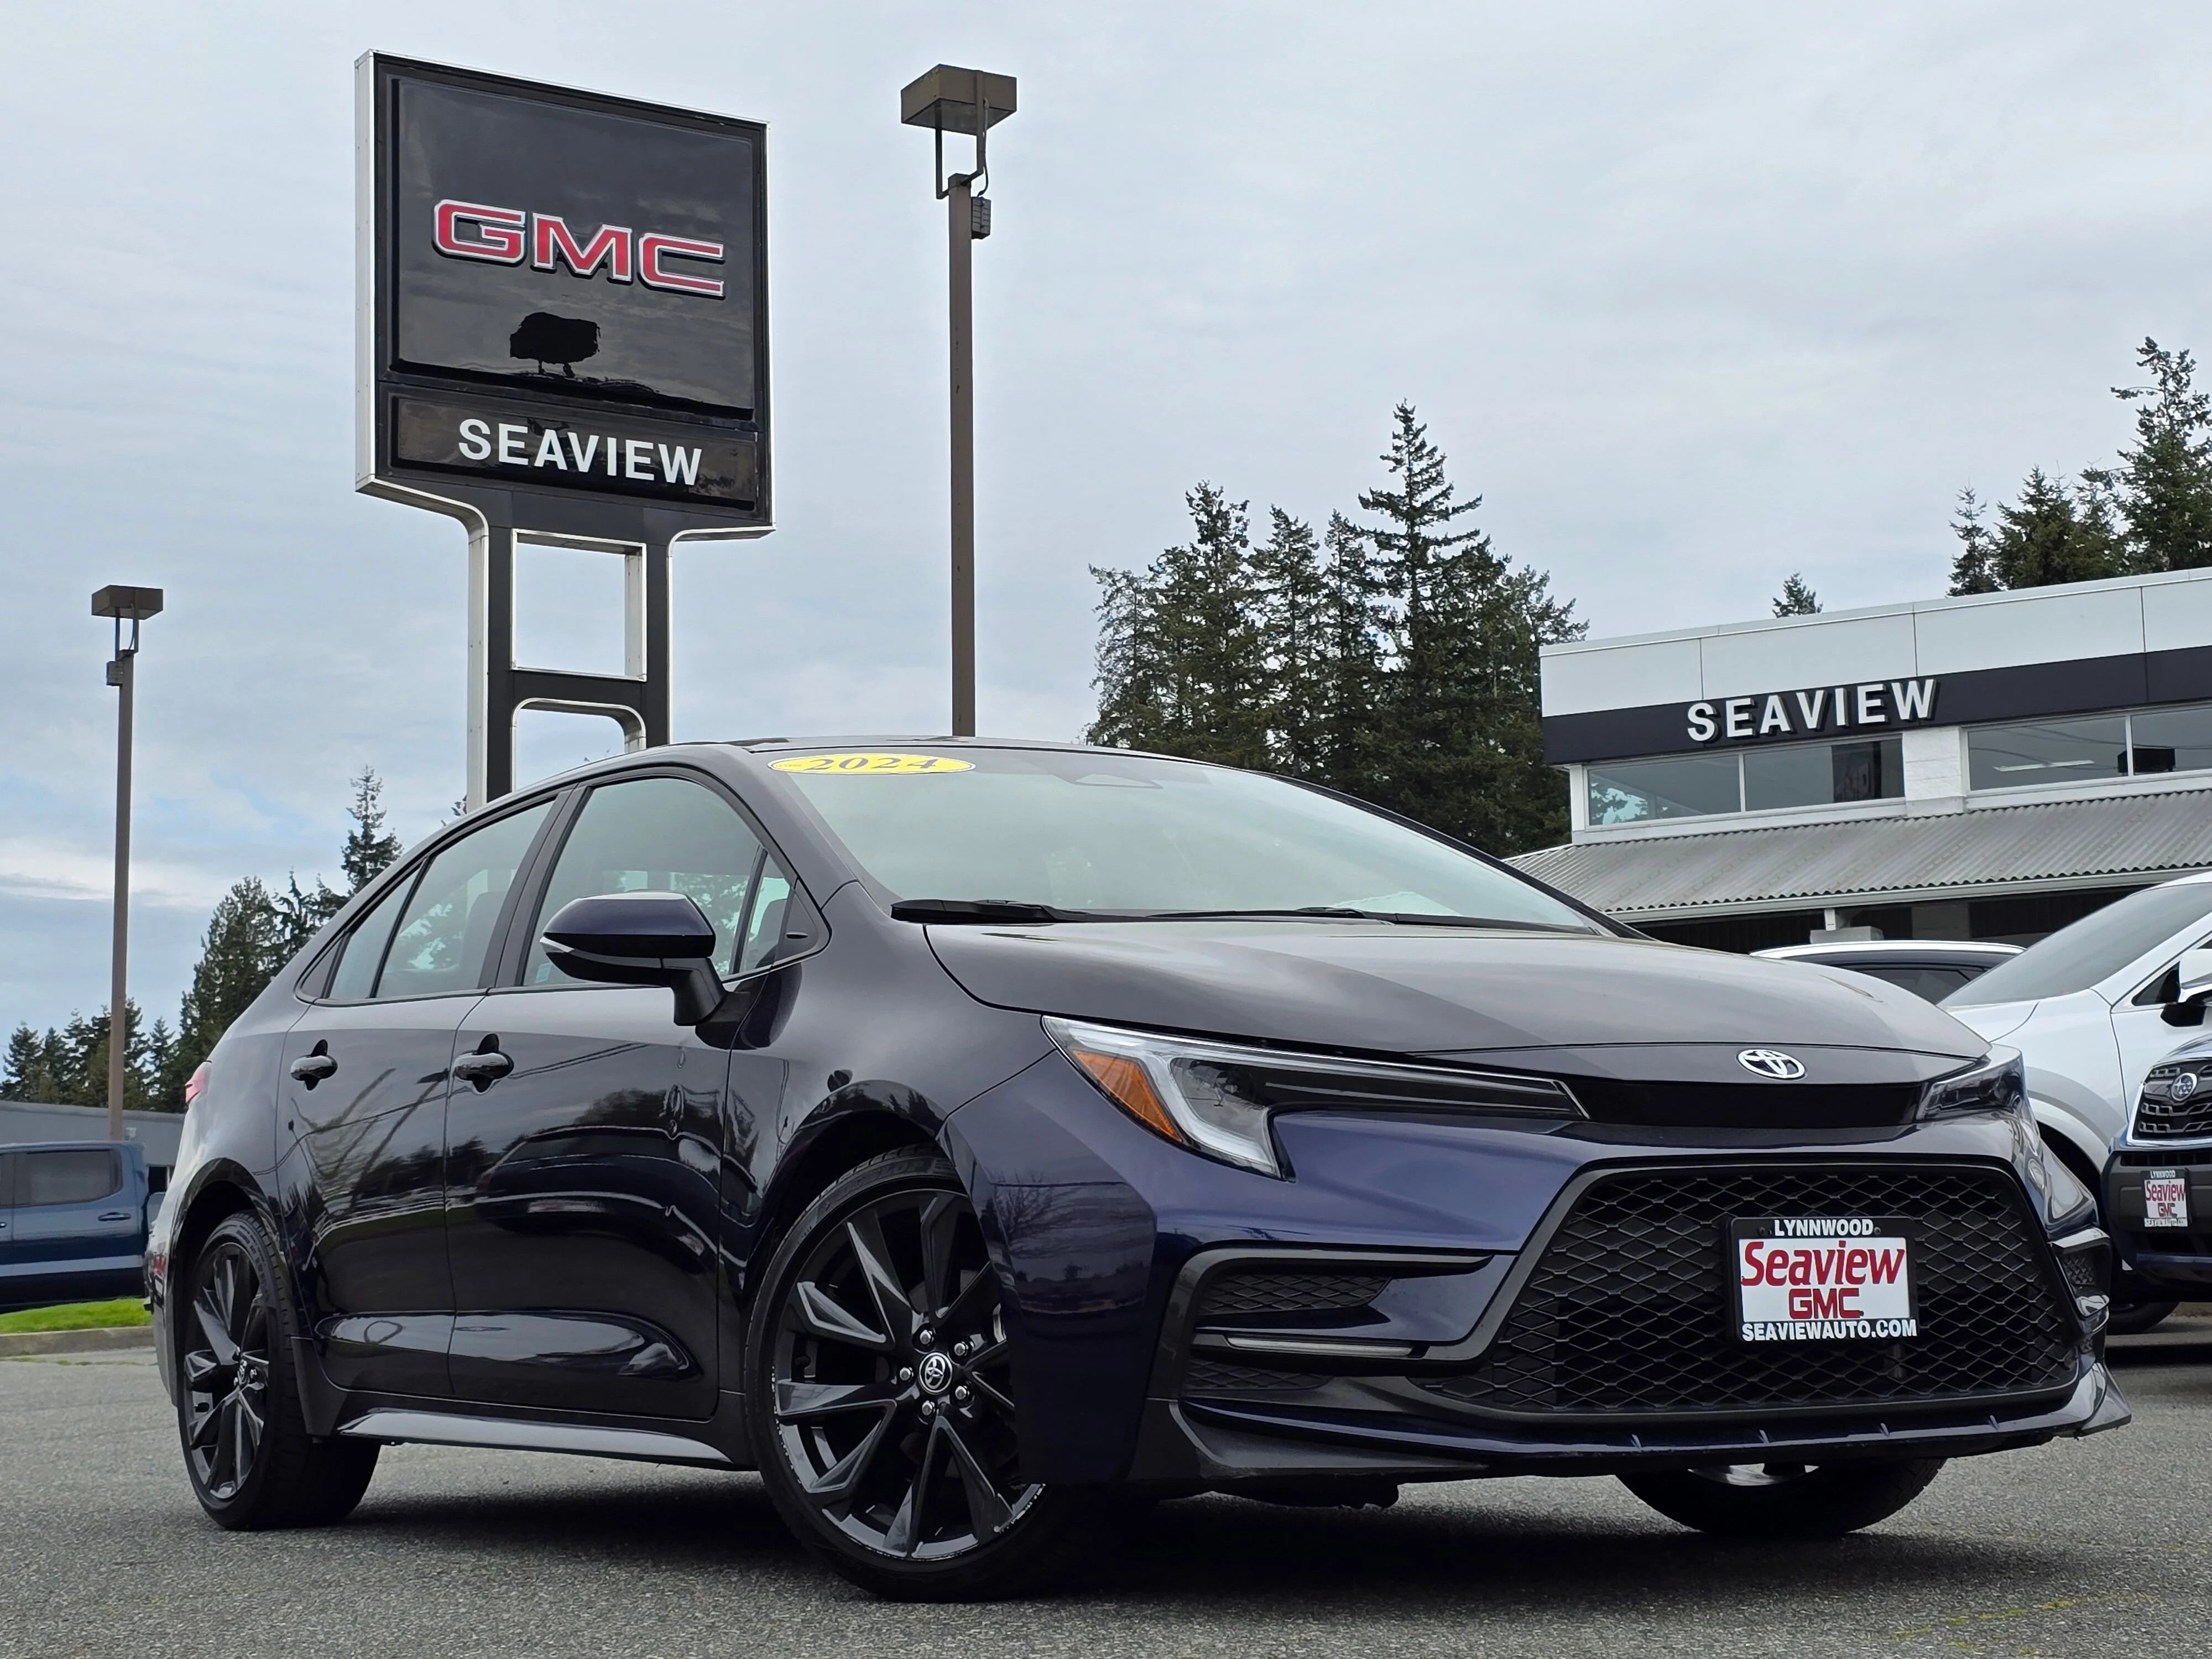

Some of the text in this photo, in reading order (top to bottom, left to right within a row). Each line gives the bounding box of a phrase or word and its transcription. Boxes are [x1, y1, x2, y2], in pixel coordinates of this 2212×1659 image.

[434, 199, 724, 296] GMC
[458, 419, 702, 486] SEAVIEW
[1687, 679, 1935, 742] SEAVIEW
[804, 756, 939, 771] 2024
[2146, 1181, 2186, 1201] Seaview
[2158, 1203, 2177, 1217] GMC
[1774, 1219, 1874, 1237] LYNNWOOD
[1741, 1240, 1906, 1286] Seaview
[1788, 1288, 1864, 1319] GMC
[1742, 1319, 1917, 1342] SEAVIEWAUTO.COM
